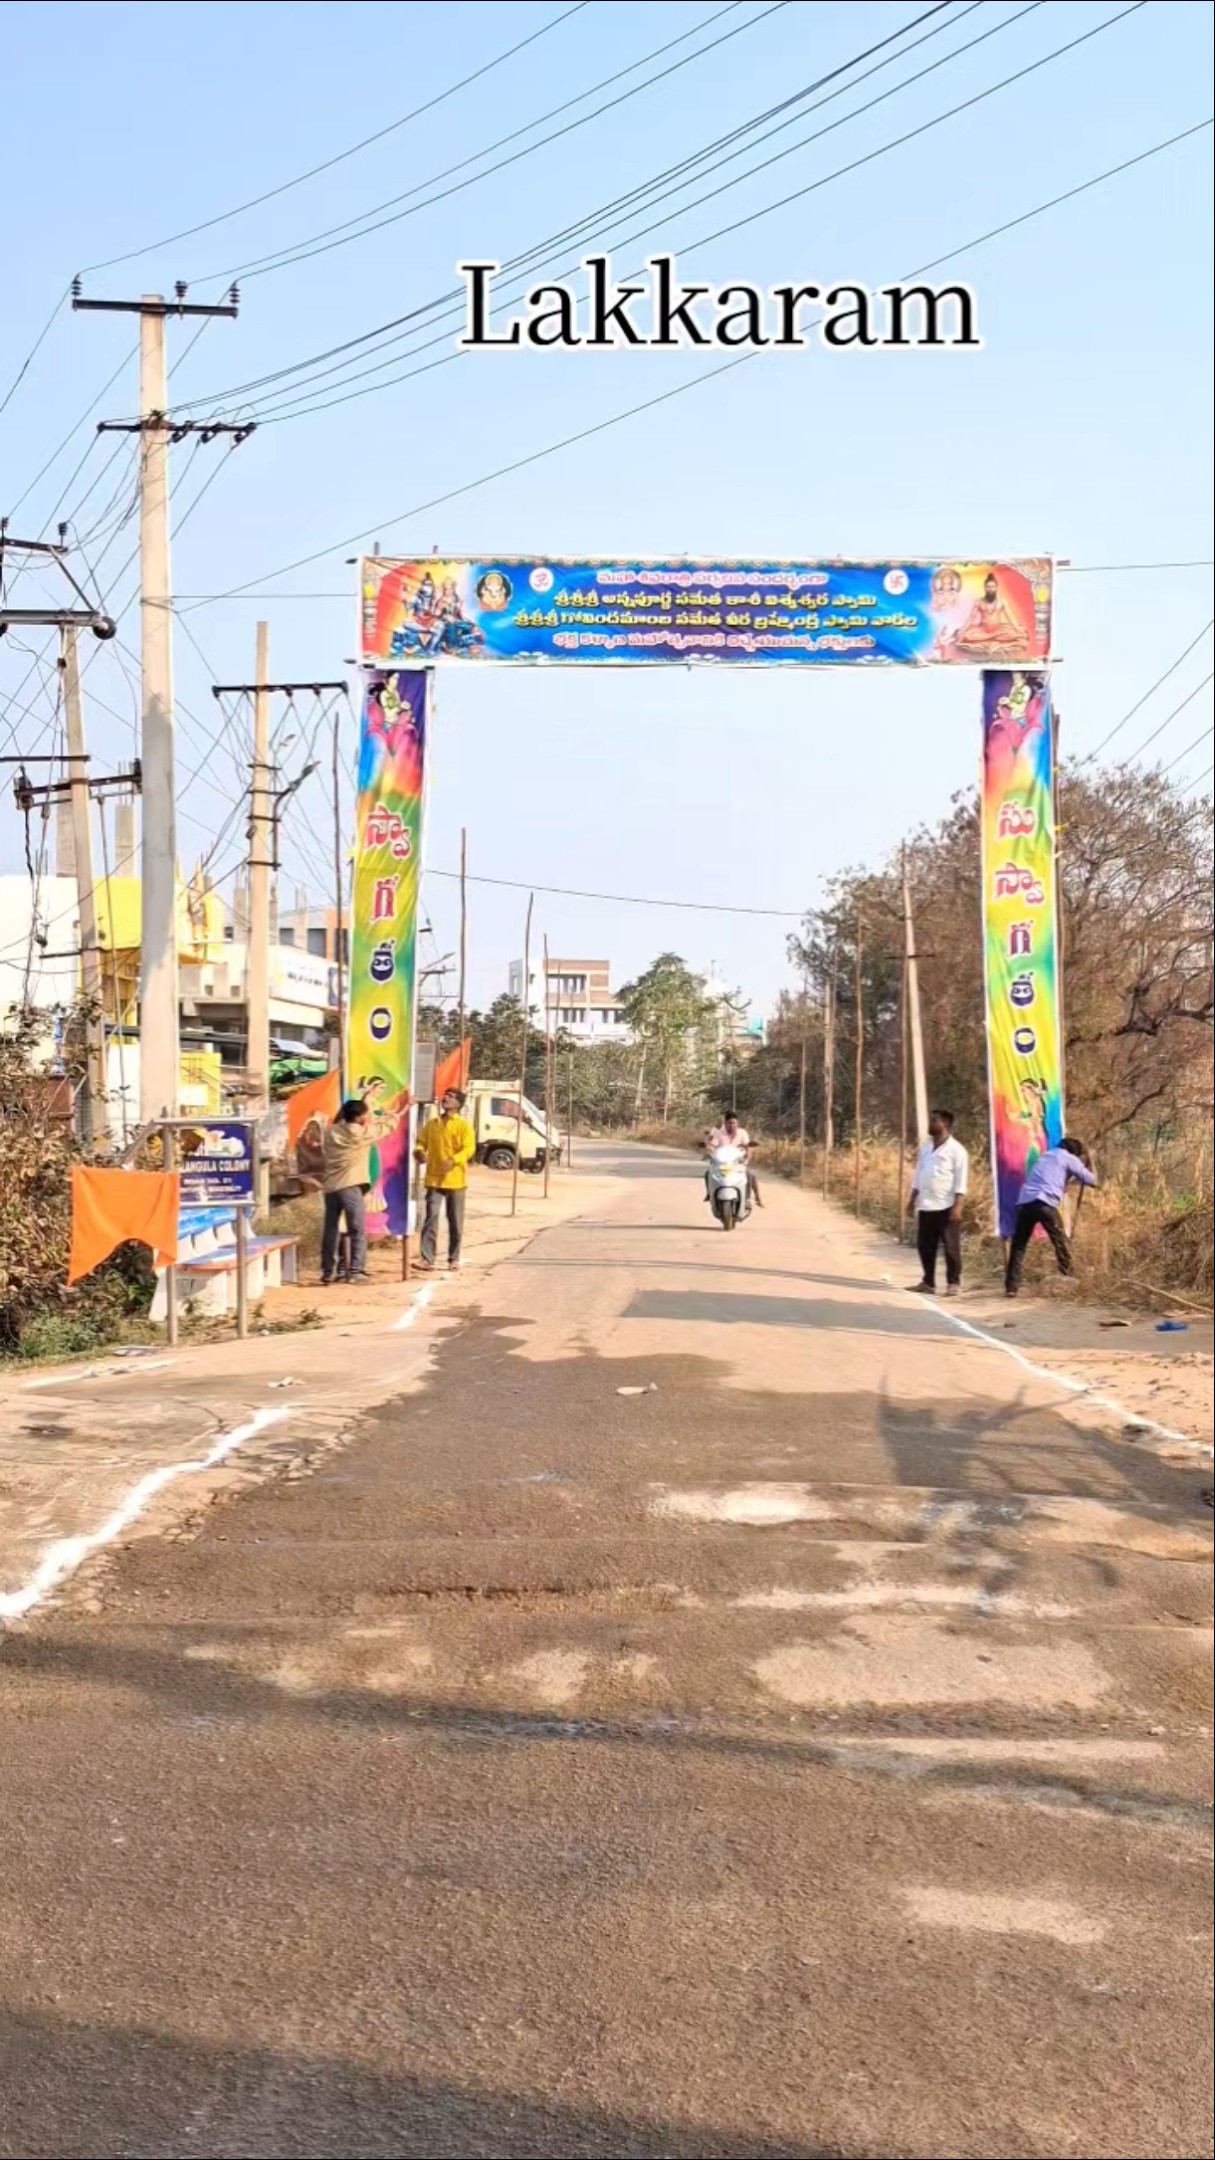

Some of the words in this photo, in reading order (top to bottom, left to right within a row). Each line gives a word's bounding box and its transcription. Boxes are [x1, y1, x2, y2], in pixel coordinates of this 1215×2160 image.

[676, 590, 722, 606] సమేత
[831, 594, 877, 608] స్వామి
[675, 610, 722, 625] సమేత
[823, 615, 868, 629] స్వామి
[218, 1159, 251, 1172] COLONY
